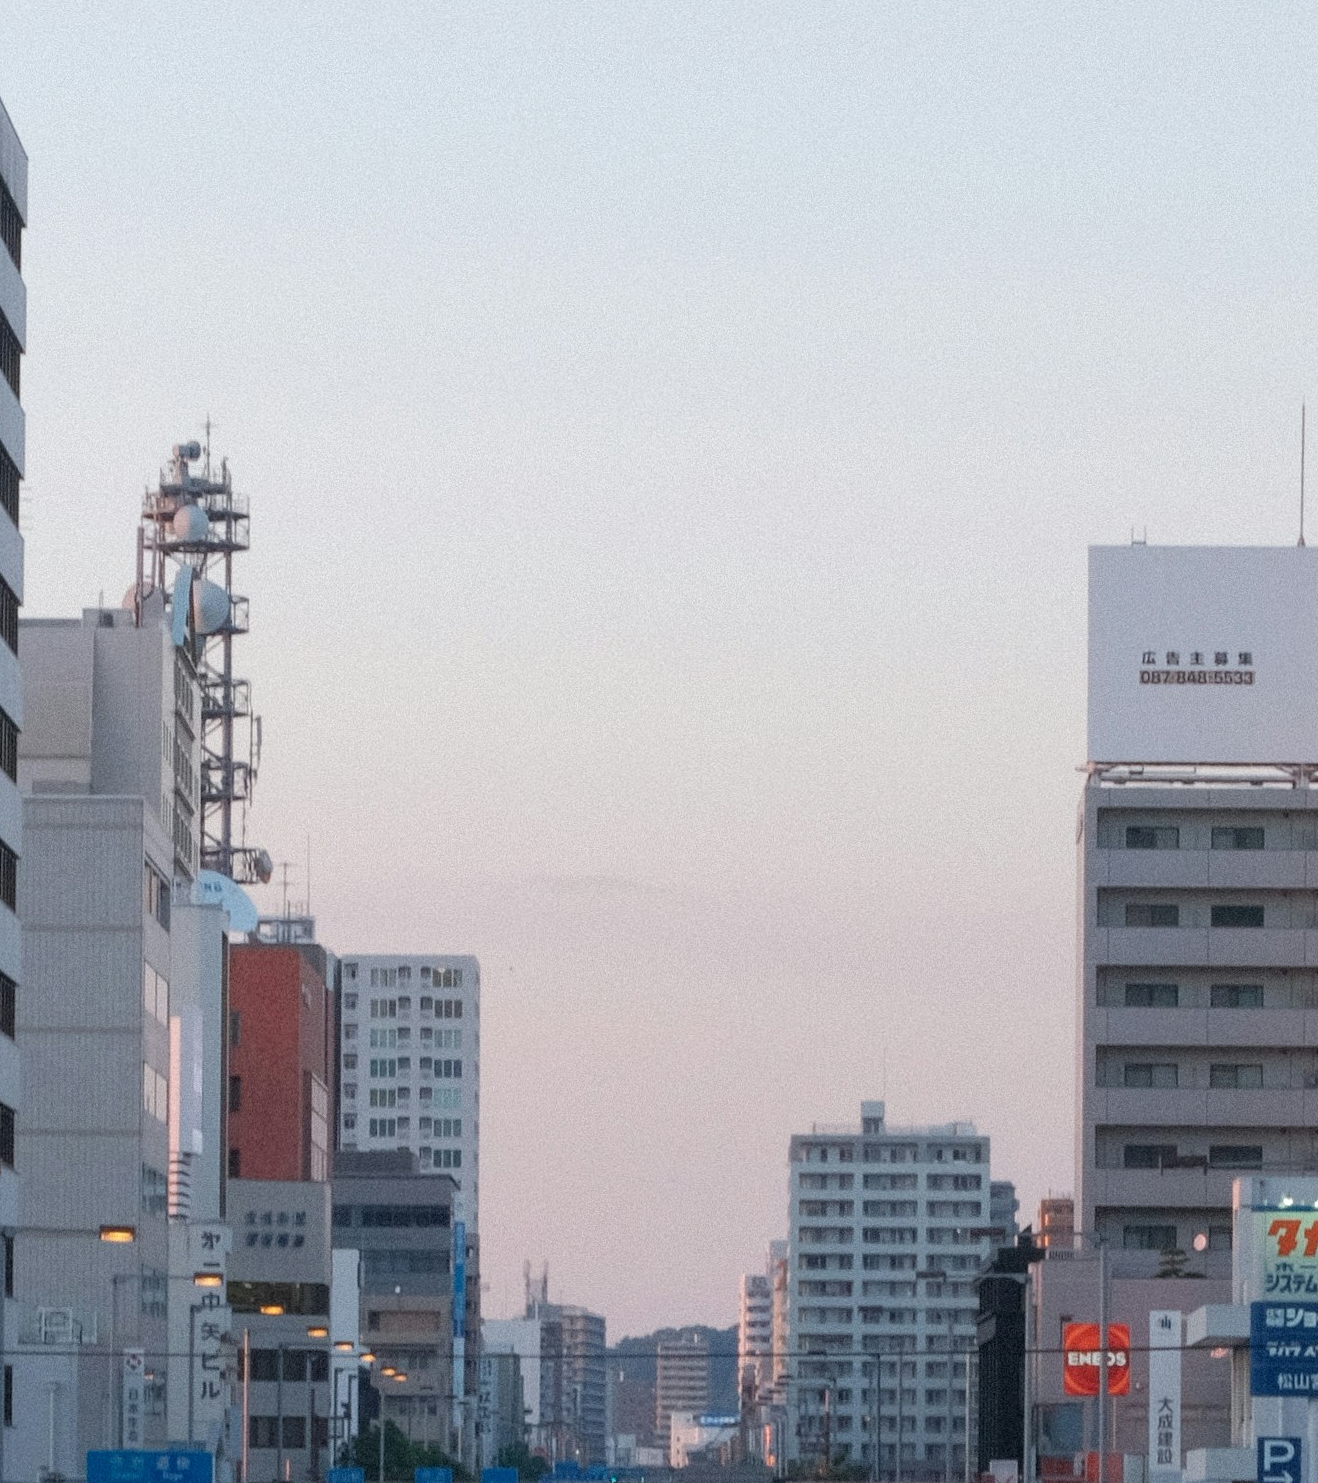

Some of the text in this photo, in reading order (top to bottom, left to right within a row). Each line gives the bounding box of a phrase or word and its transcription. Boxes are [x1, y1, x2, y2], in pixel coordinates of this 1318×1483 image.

[1156, 1397, 1174, 1465] 大成建設
[1263, 1440, 1295, 1472] P
